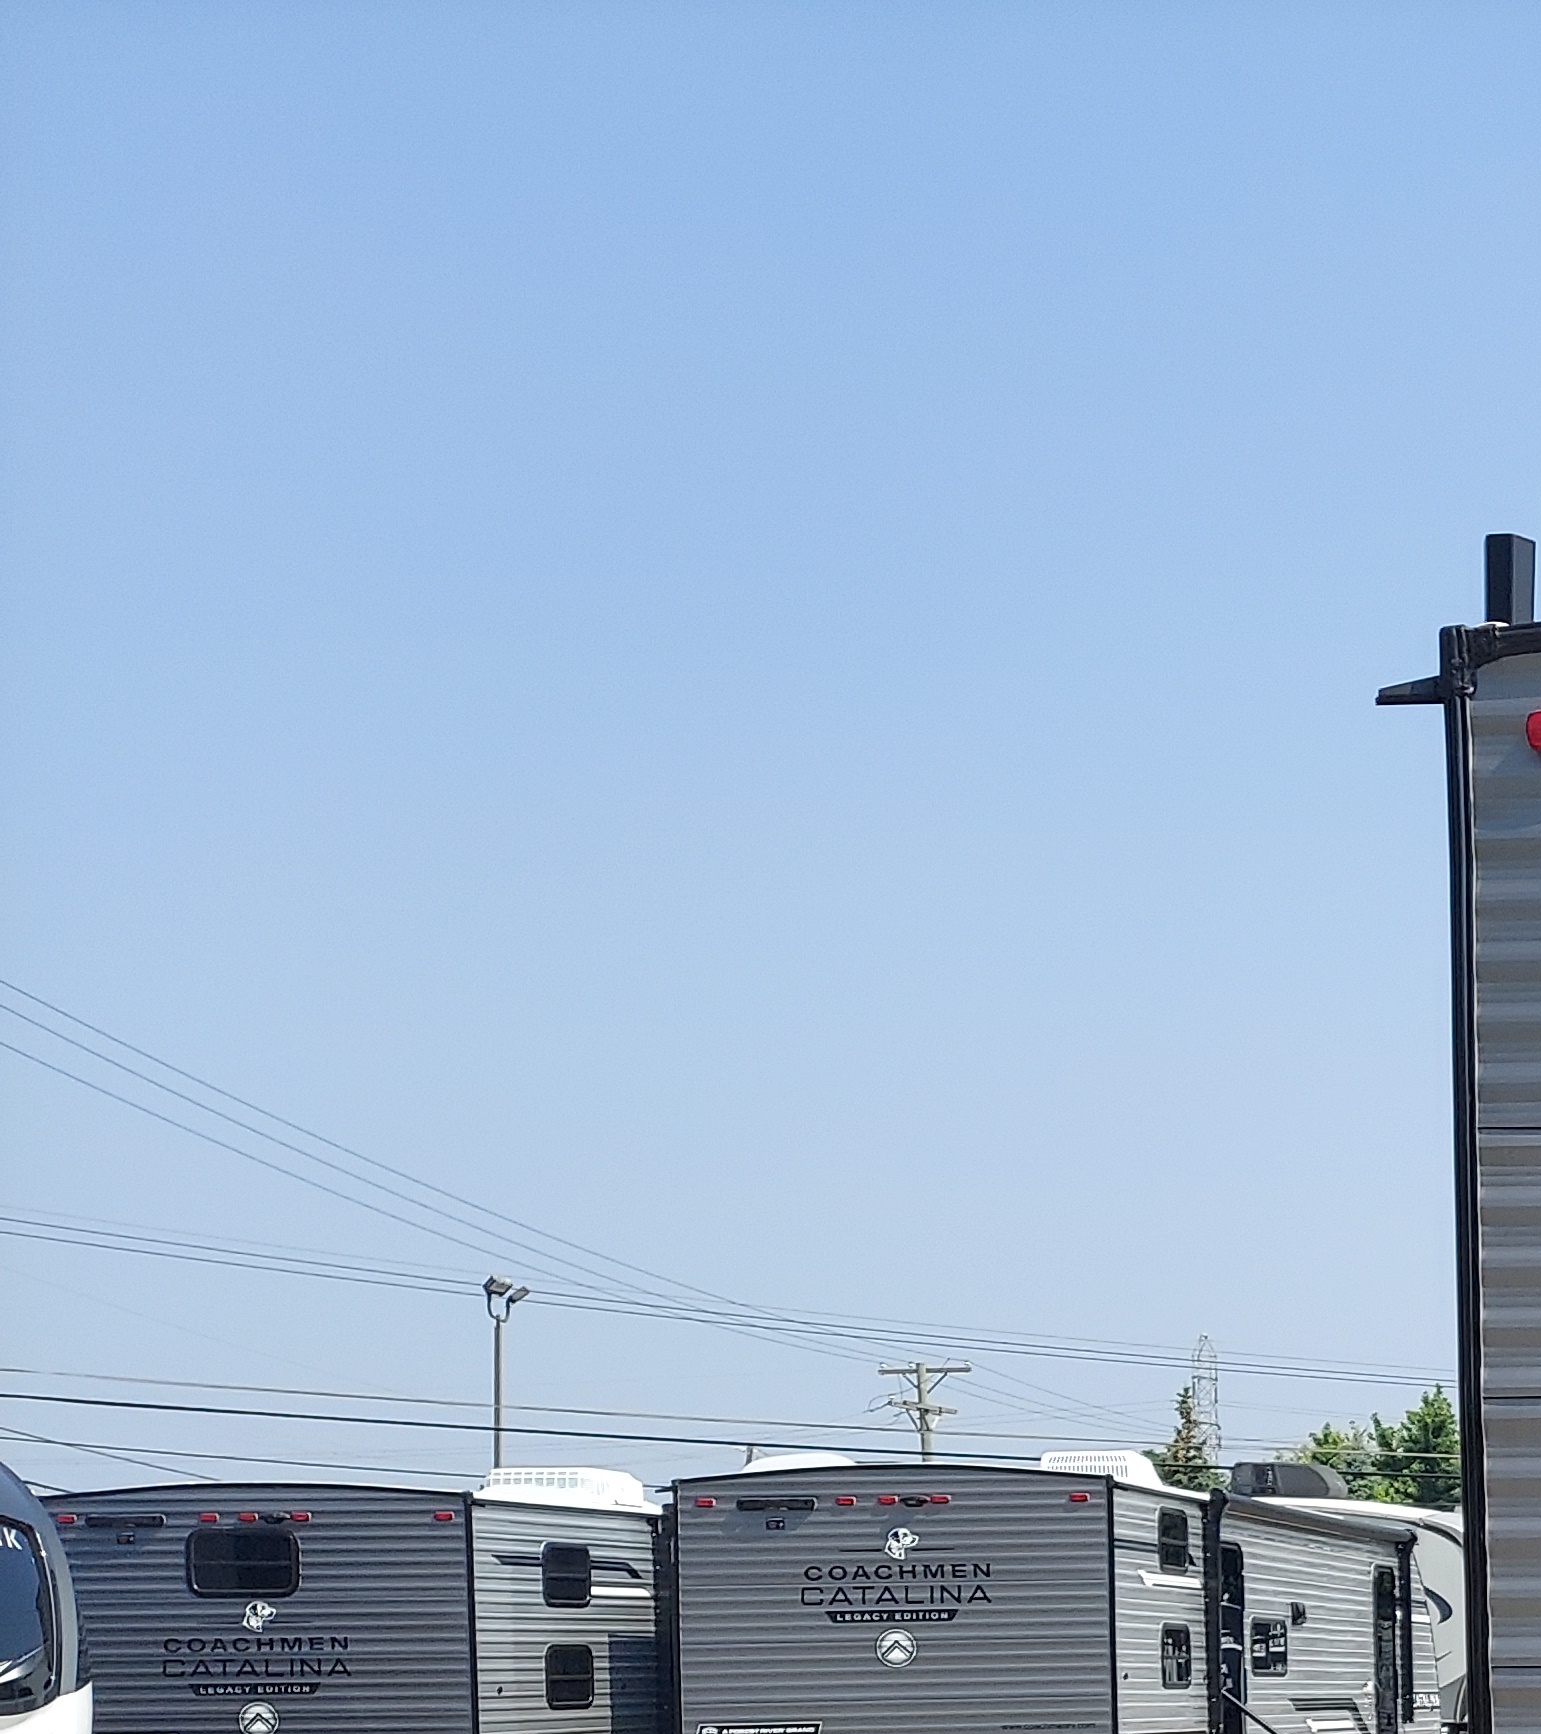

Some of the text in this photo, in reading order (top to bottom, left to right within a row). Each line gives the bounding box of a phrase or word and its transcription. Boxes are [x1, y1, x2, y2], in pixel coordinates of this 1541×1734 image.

[803, 1563, 991, 1582] COACHMEN
[800, 1584, 993, 1606] CATALINA
[836, 1611, 949, 1622] LEGACY EDITION
[163, 1636, 349, 1653] COACHMEN
[162, 1658, 352, 1677] CATALINA
